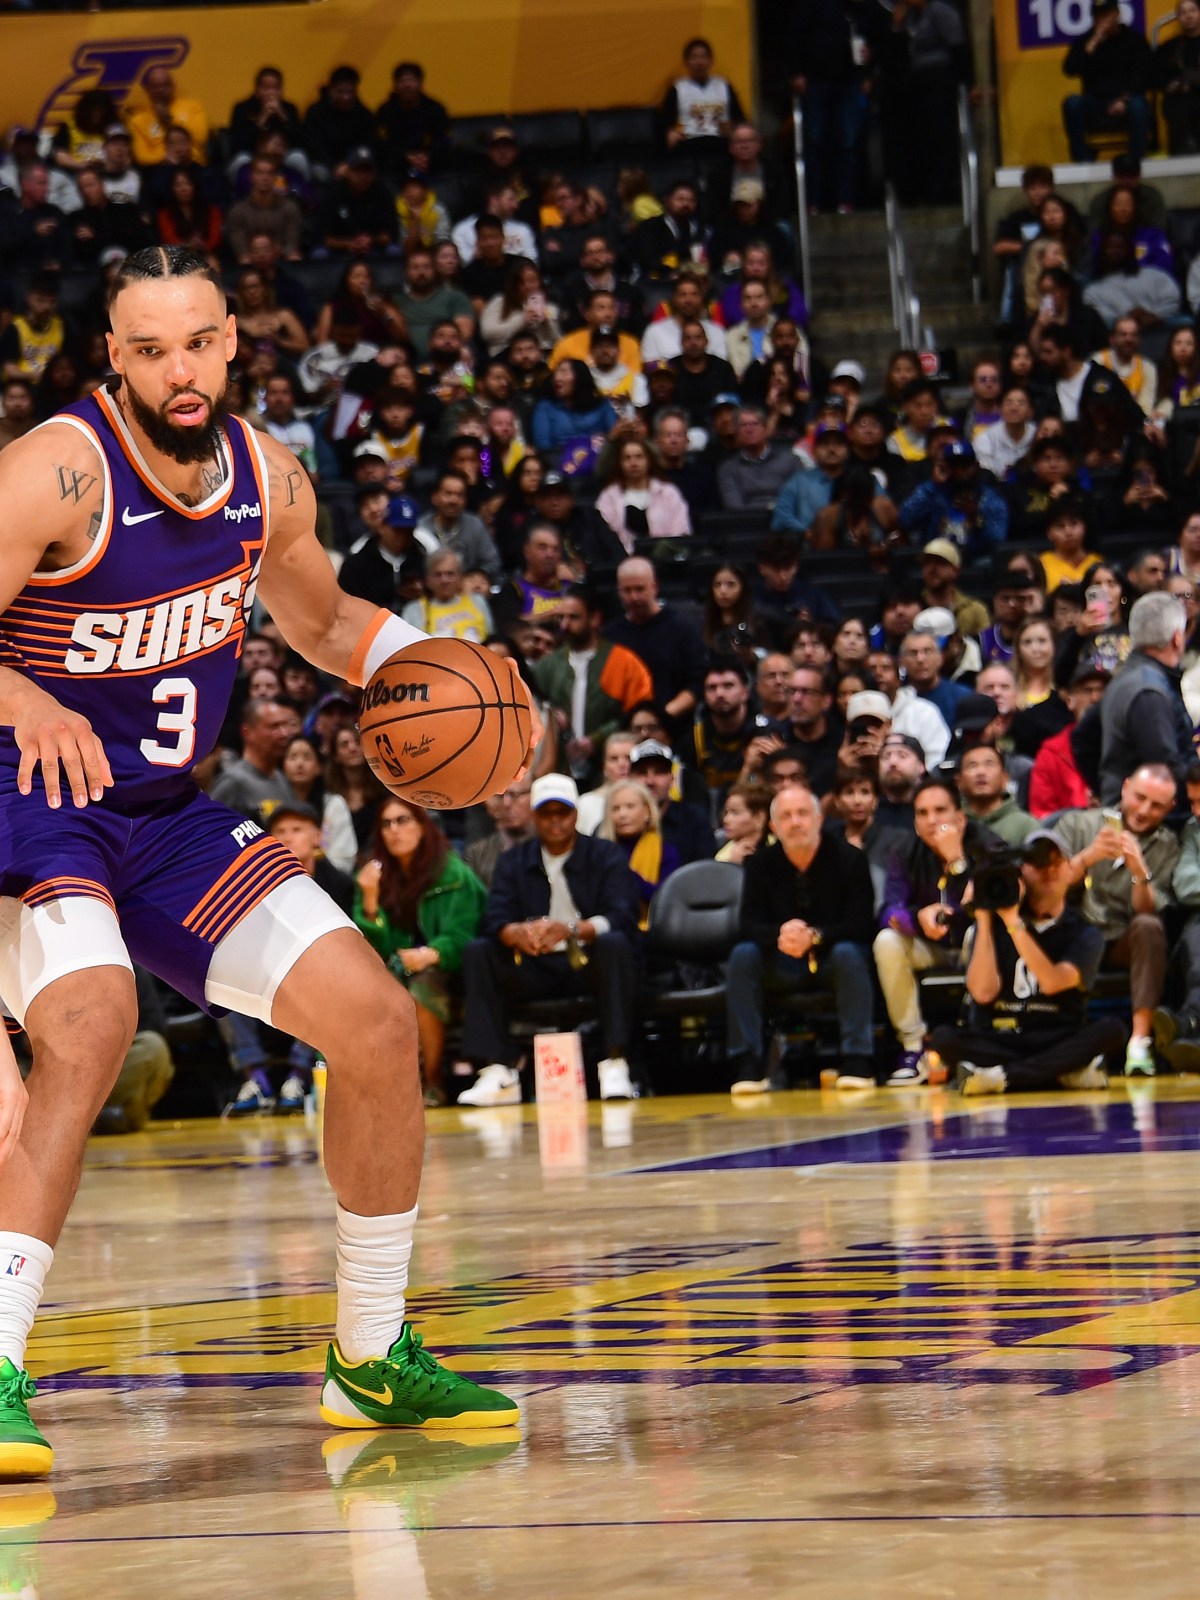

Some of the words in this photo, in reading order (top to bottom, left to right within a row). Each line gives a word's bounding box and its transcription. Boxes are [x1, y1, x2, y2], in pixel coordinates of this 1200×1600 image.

[1029, 0, 1134, 39] 10
[224, 502, 261, 524] PayPal
[139, 677, 198, 768] 3
